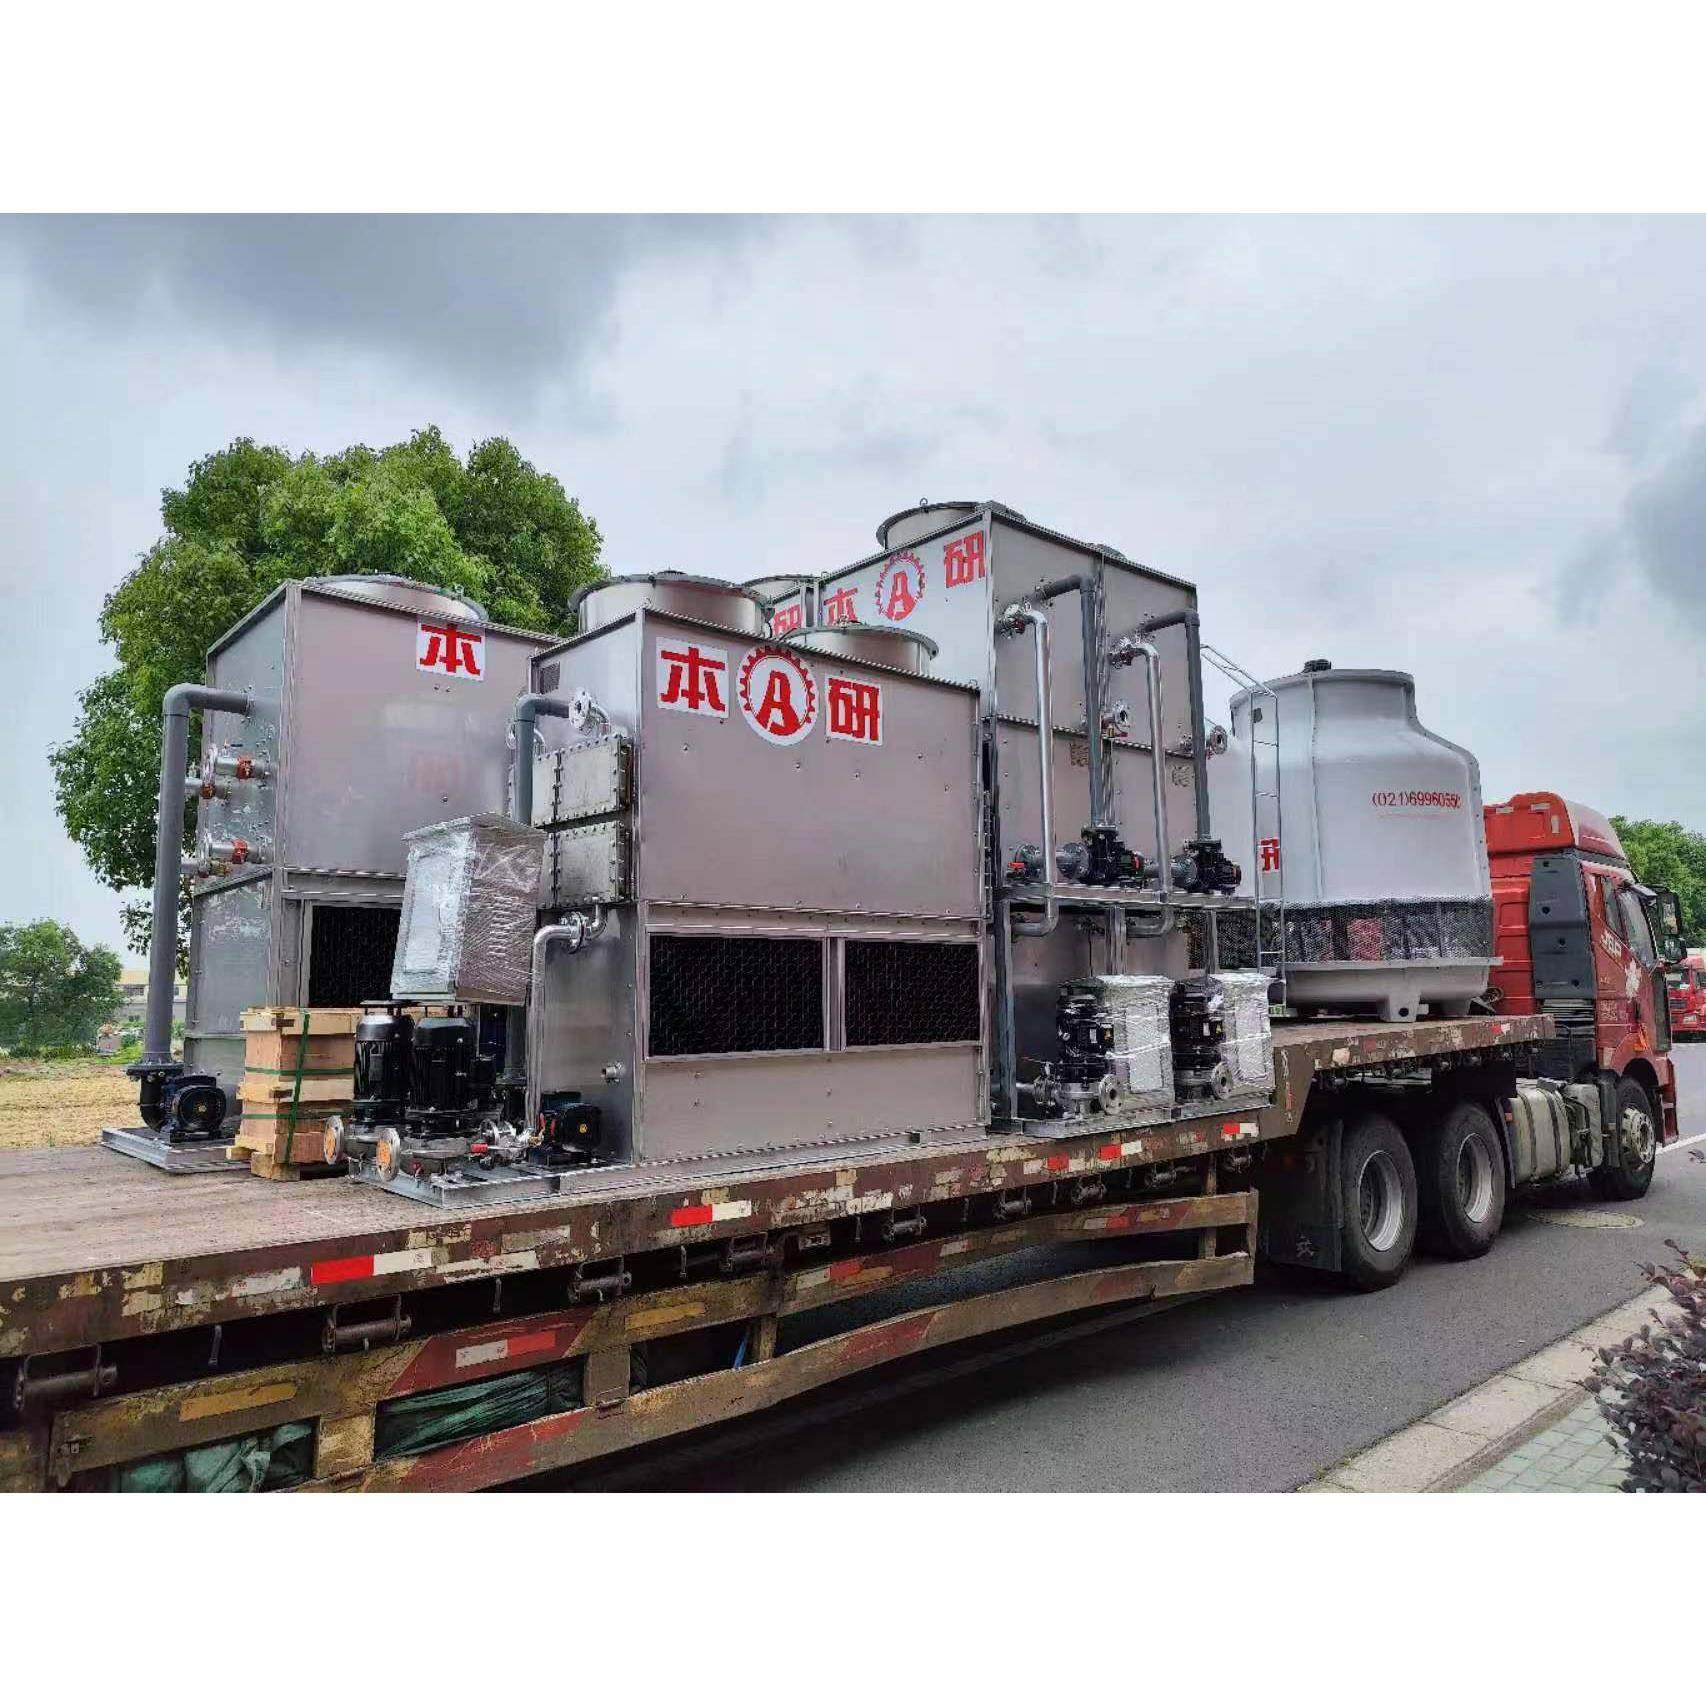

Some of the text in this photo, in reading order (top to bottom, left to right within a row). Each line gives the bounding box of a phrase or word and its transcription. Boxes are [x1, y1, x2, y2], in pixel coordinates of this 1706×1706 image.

[943, 530, 985, 588] 研
[420, 622, 481, 677] 本
[661, 647, 879, 741] 本 A 研
